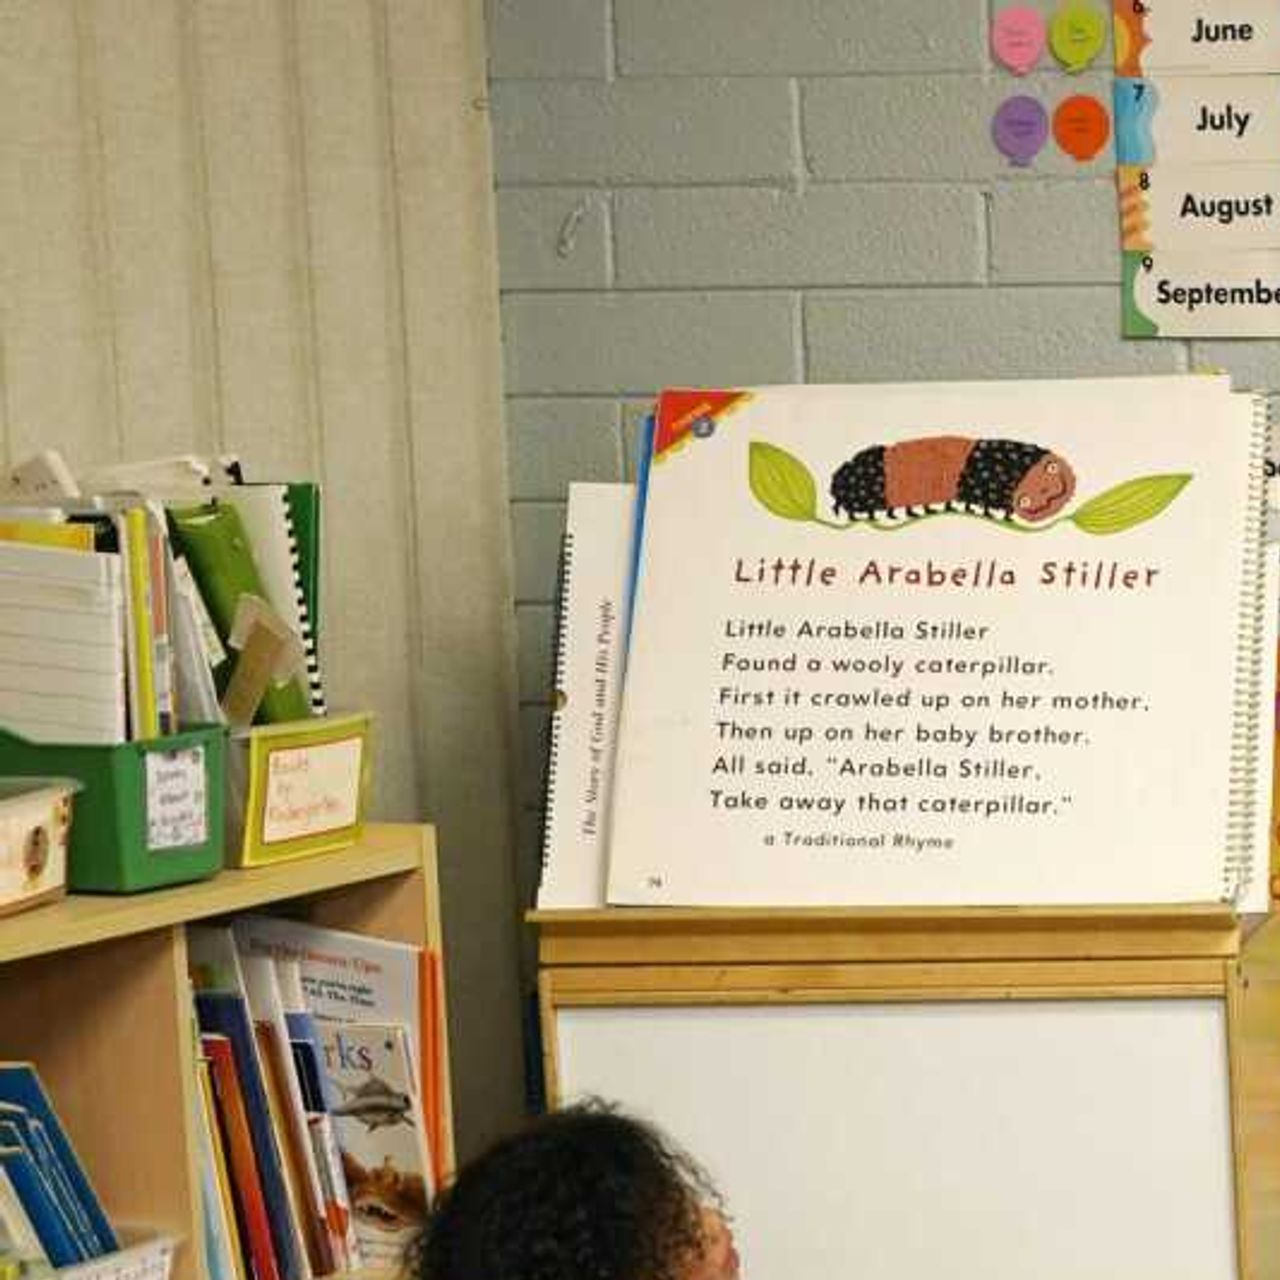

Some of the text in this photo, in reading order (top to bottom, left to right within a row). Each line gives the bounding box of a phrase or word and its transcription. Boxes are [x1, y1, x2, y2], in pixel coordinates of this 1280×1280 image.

[1191, 19, 1253, 43] June
[1133, 84, 1144, 101] 7
[1196, 106, 1251, 137] July
[1138, 172, 1150, 191] 8
[1179, 194, 1274, 225] August
[1142, 256, 1153, 273] 9
[733, 557, 1160, 591] Little Arabella Stiller
[725, 619, 989, 641] Little Arabella Stiller
[722, 653, 1054, 678] Found a wooly caterpillar.
[719, 688, 774, 708] First
[785, 690, 800, 708] it
[810, 689, 911, 709] crawled
[921, 693, 949, 712] up
[962, 693, 990, 710] on
[1001, 690, 1039, 711] her
[716, 722, 1090, 748] Then up on her baby brother.
[712, 756, 745, 775] All
[710, 790, 1071, 818] Take away that caterpillar."
[764, 832, 955, 853] a Traditional Rhyme
